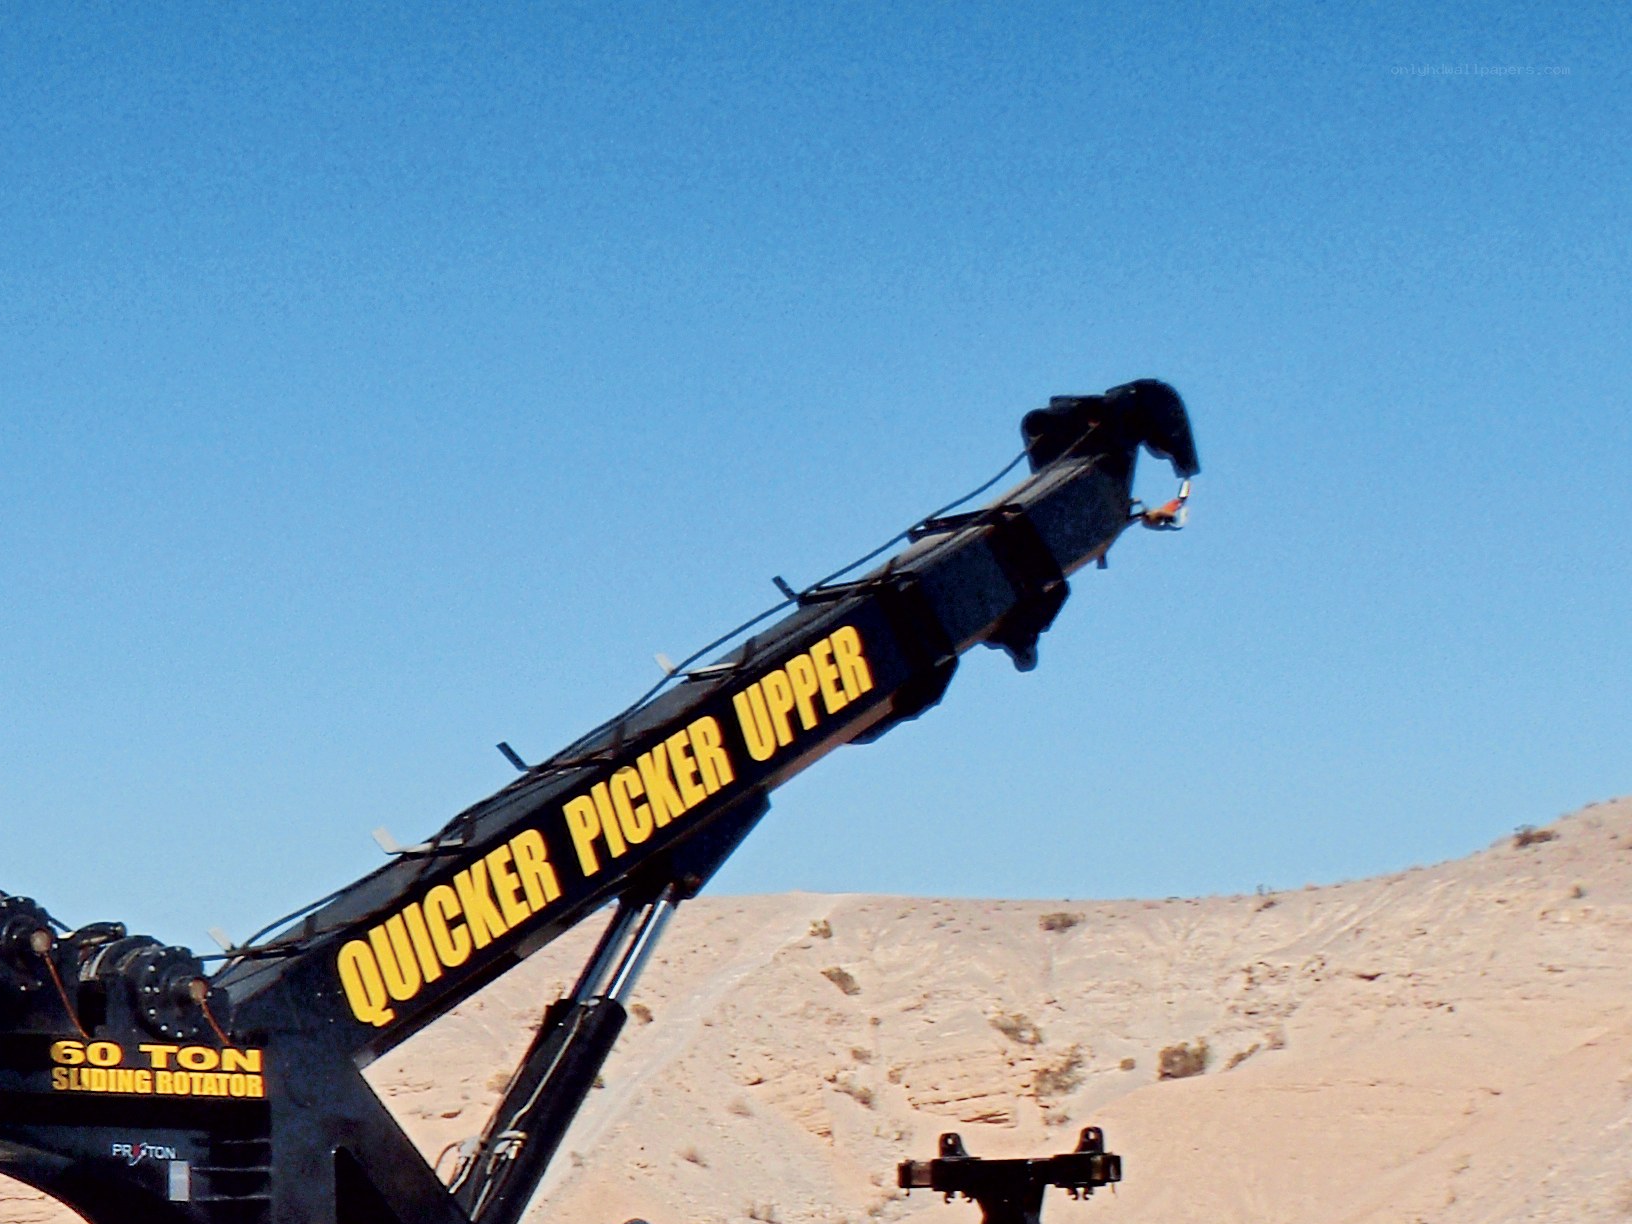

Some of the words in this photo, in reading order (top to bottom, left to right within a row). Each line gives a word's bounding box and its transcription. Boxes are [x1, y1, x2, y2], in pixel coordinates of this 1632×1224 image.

[336, 828, 562, 1028] QUICKER
[562, 714, 735, 878] PICKER
[732, 624, 874, 762] UPPER
[50, 1040, 122, 1067] 60
[139, 1044, 262, 1073] TON
[52, 1066, 153, 1094] SLIDING
[155, 1070, 264, 1098] ROTATOR
